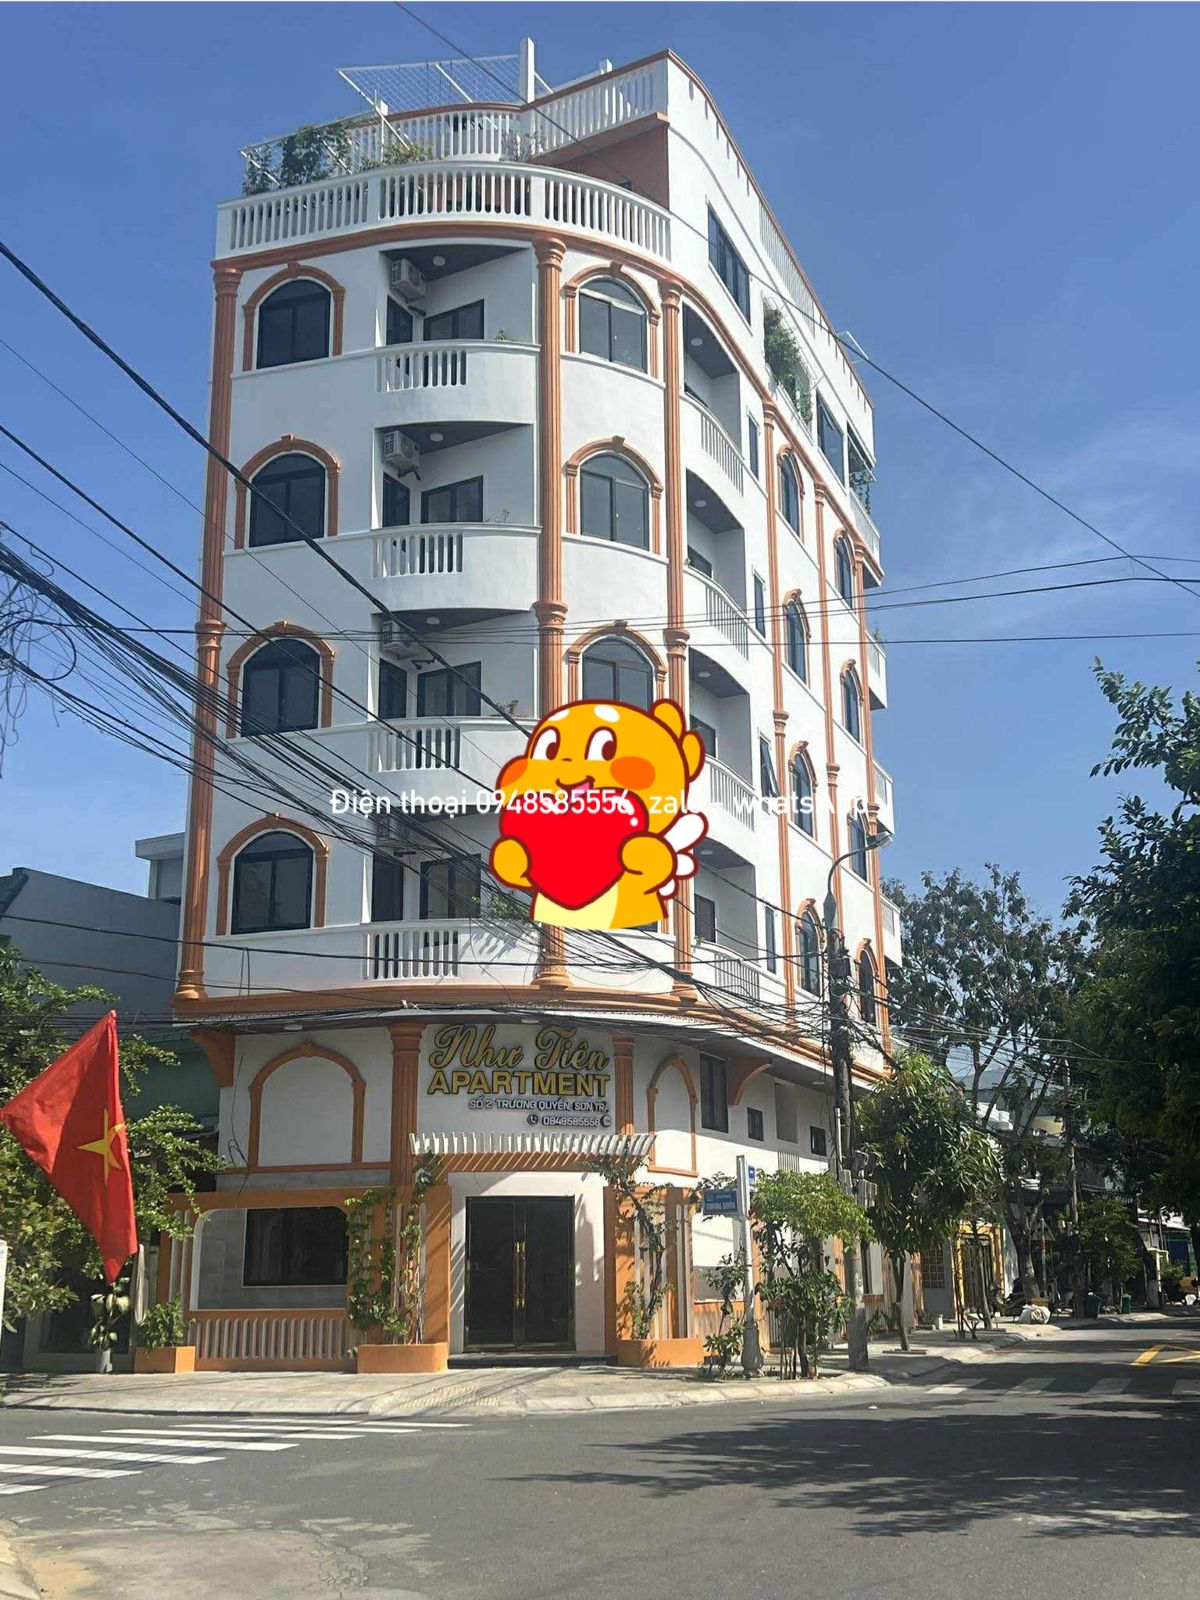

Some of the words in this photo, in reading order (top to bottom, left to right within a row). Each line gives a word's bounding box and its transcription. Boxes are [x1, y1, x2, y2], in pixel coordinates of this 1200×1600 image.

[428, 1024, 525, 1069] Như
[534, 1024, 610, 1071] Tiên
[427, 1070, 610, 1097] APARTMENT
